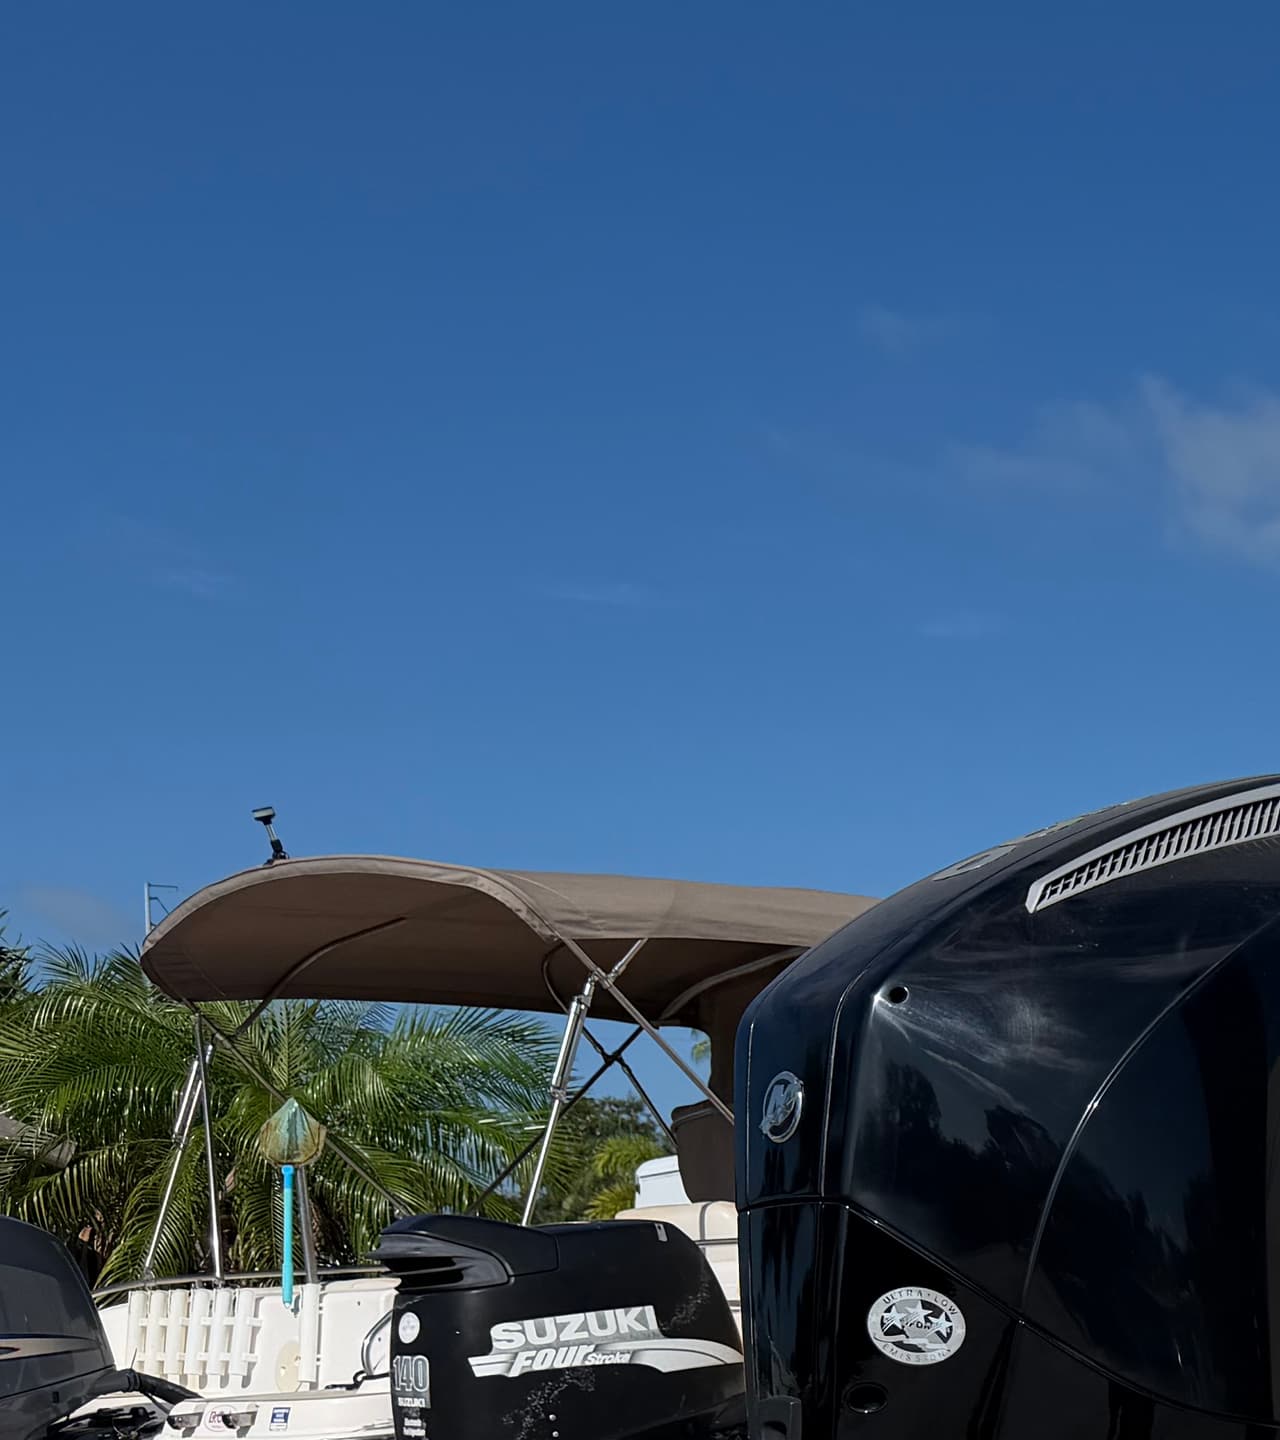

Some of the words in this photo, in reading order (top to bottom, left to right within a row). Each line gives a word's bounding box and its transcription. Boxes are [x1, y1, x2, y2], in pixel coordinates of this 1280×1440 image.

[882, 1289, 923, 1305] ULTRA
[934, 1297, 958, 1316] LOW
[490, 1306, 658, 1350] SUZUKI
[392, 1354, 430, 1392] 140
